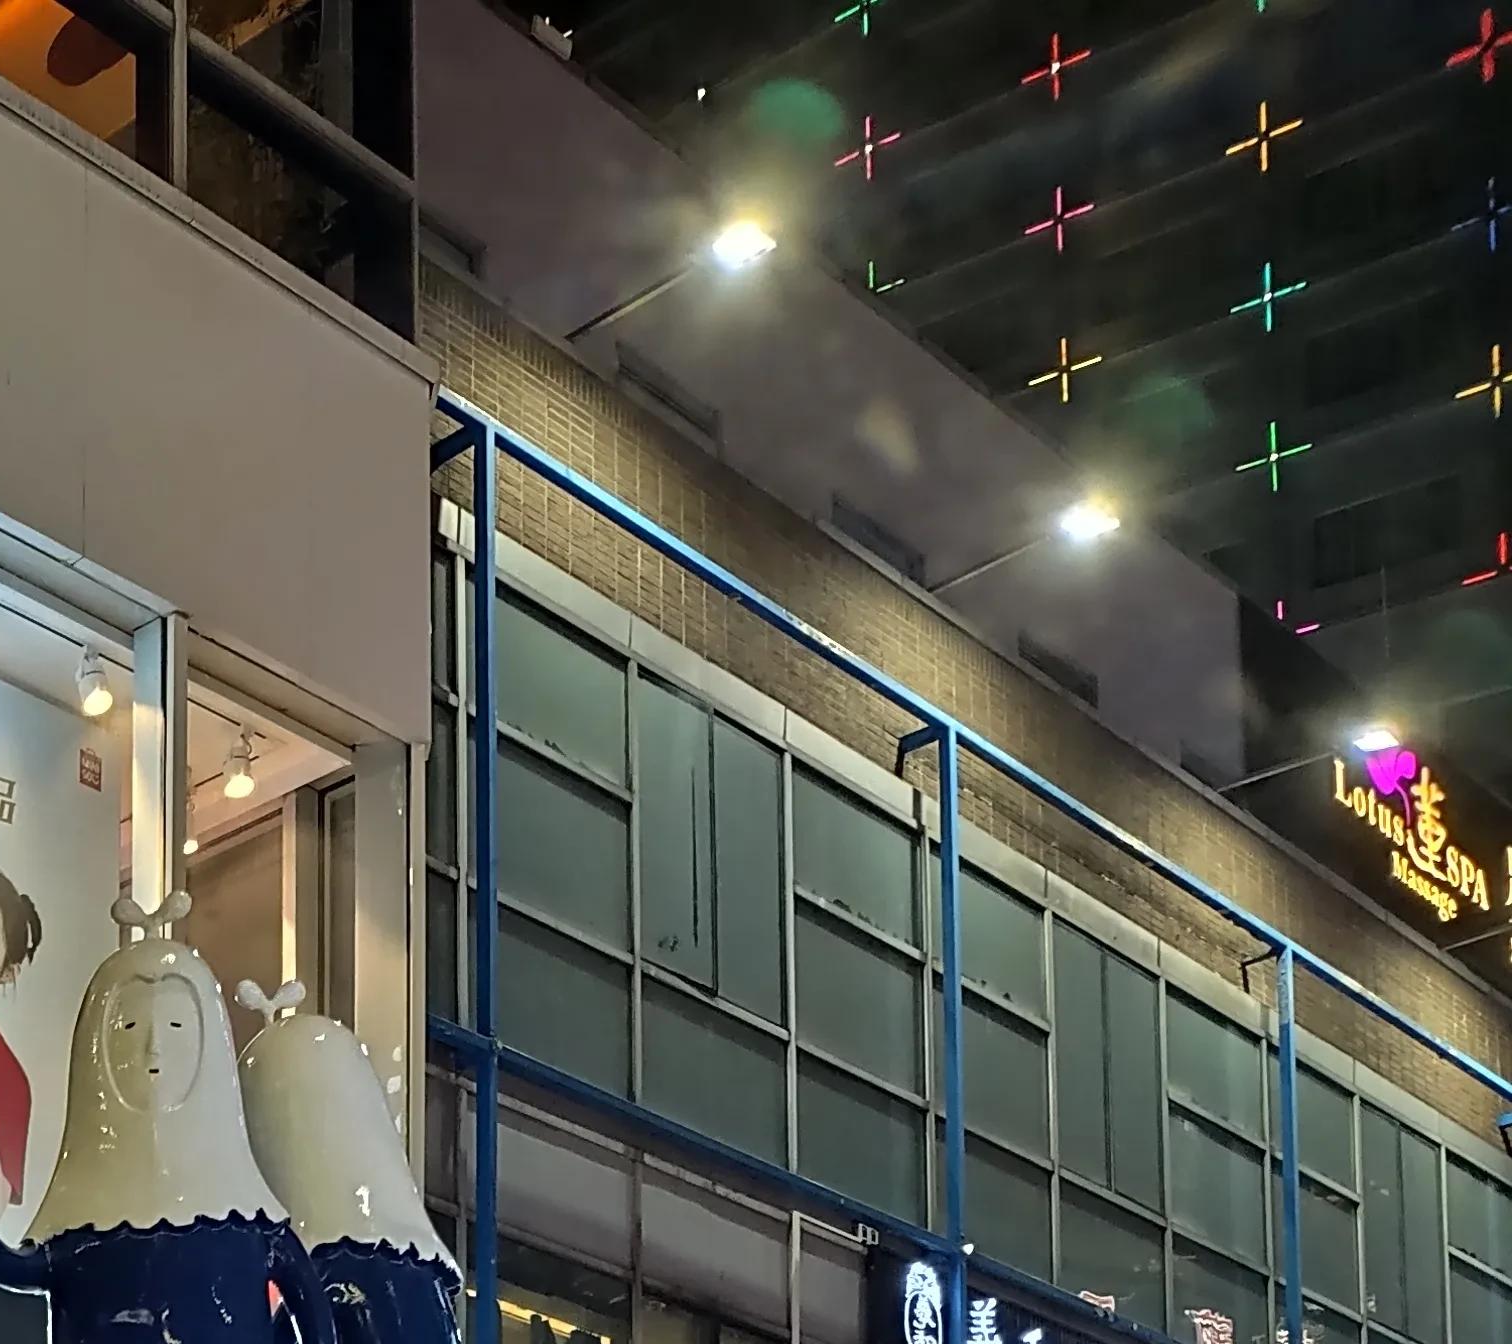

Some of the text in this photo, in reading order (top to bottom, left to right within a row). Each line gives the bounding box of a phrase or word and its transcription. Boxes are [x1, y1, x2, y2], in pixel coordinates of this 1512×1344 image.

[1334, 758, 1404, 847] Lotus
[1391, 850, 1458, 922] Massage
[1446, 845, 1489, 911] SPA
